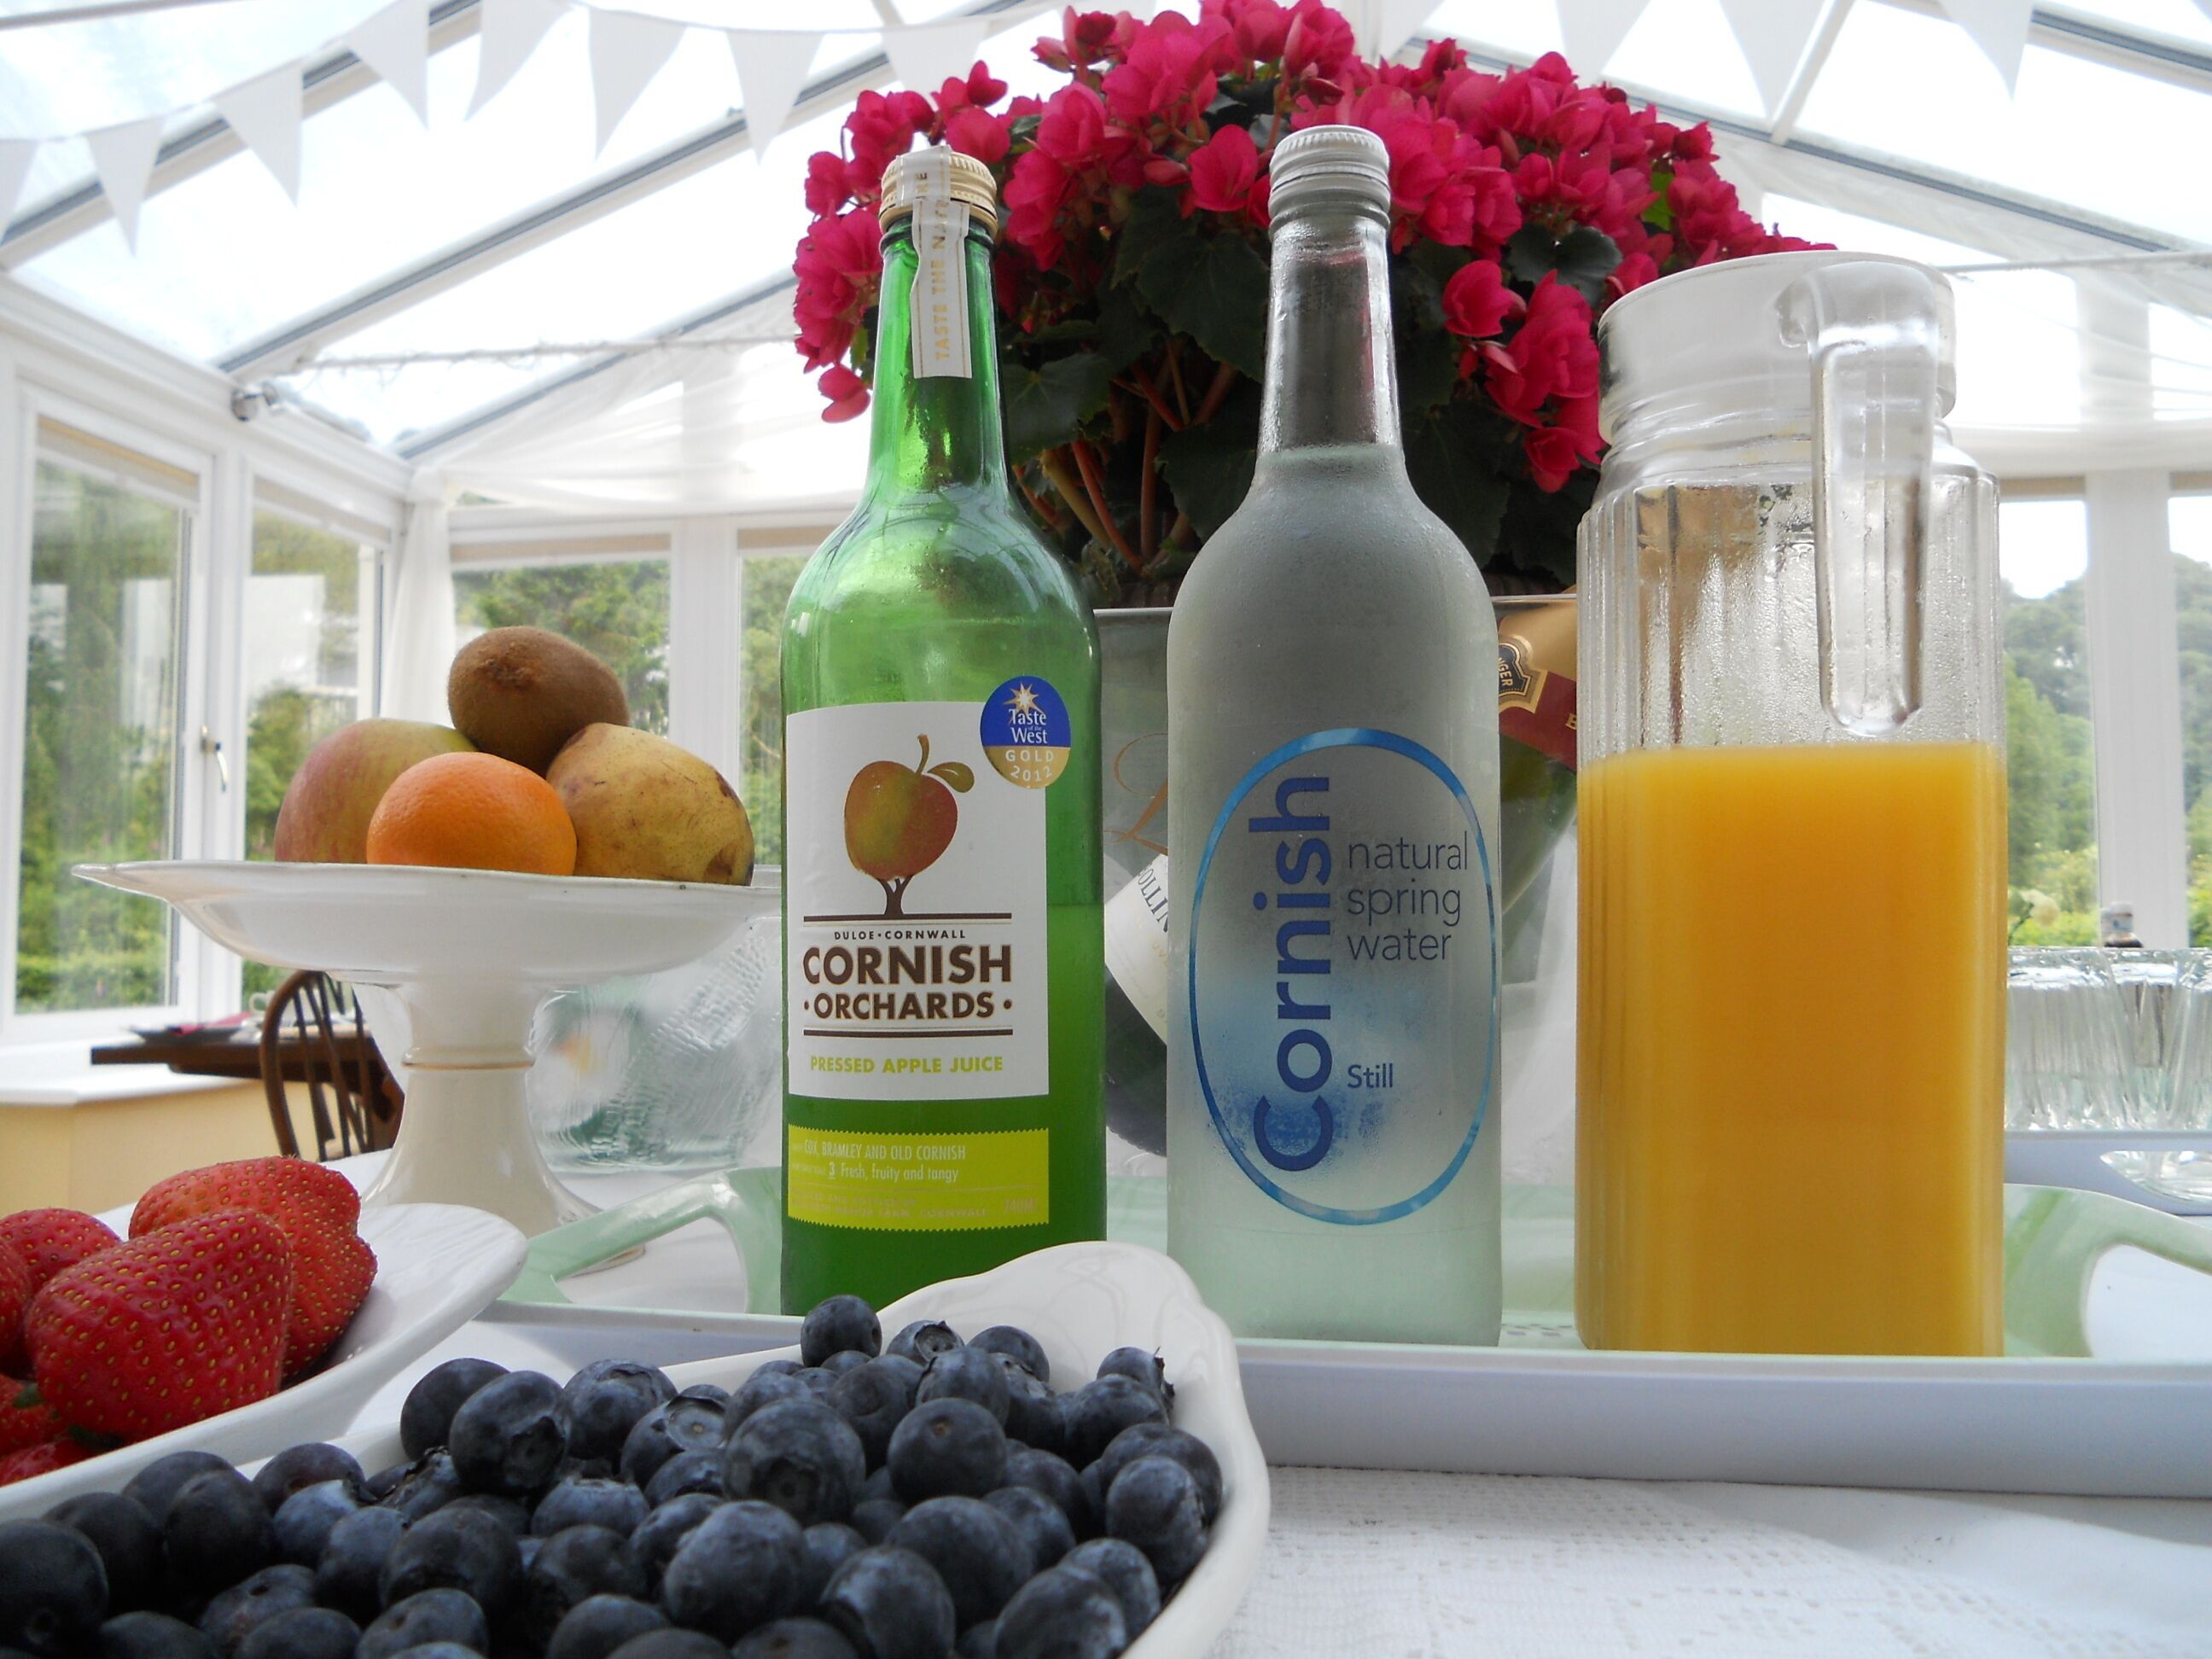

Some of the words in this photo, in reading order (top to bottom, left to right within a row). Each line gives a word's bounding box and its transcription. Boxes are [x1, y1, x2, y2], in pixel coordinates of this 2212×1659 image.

[930, 259, 946, 295] THE
[933, 304, 950, 360] TASTE
[1008, 708, 1047, 725] Taste
[1010, 727, 1048, 744] West
[1005, 749, 1054, 762] GOLD
[1010, 765, 1052, 782] 2012
[1348, 831, 1468, 870] natural
[1348, 879, 1461, 927] spring
[884, 929, 966, 940] CORNWALL
[1348, 933, 1452, 961] water
[803, 945, 1012, 985] CORNISH
[1249, 777, 1334, 1172] Cornish
[813, 991, 995, 1021] ORCHARDS
[811, 1055, 874, 1074] PRESSED
[882, 1057, 942, 1074] APPLE
[949, 1056, 1003, 1072] JUICE
[1348, 1064, 1394, 1089] Still
[822, 1141, 862, 1159] BRAMLEY
[864, 1144, 887, 1160] AND
[890, 1145, 912, 1161] OLD
[917, 1144, 966, 1161] CORNISH
[872, 1163, 900, 1184] fruity
[904, 1164, 924, 1179] and
[928, 1167, 958, 1184] tangy
